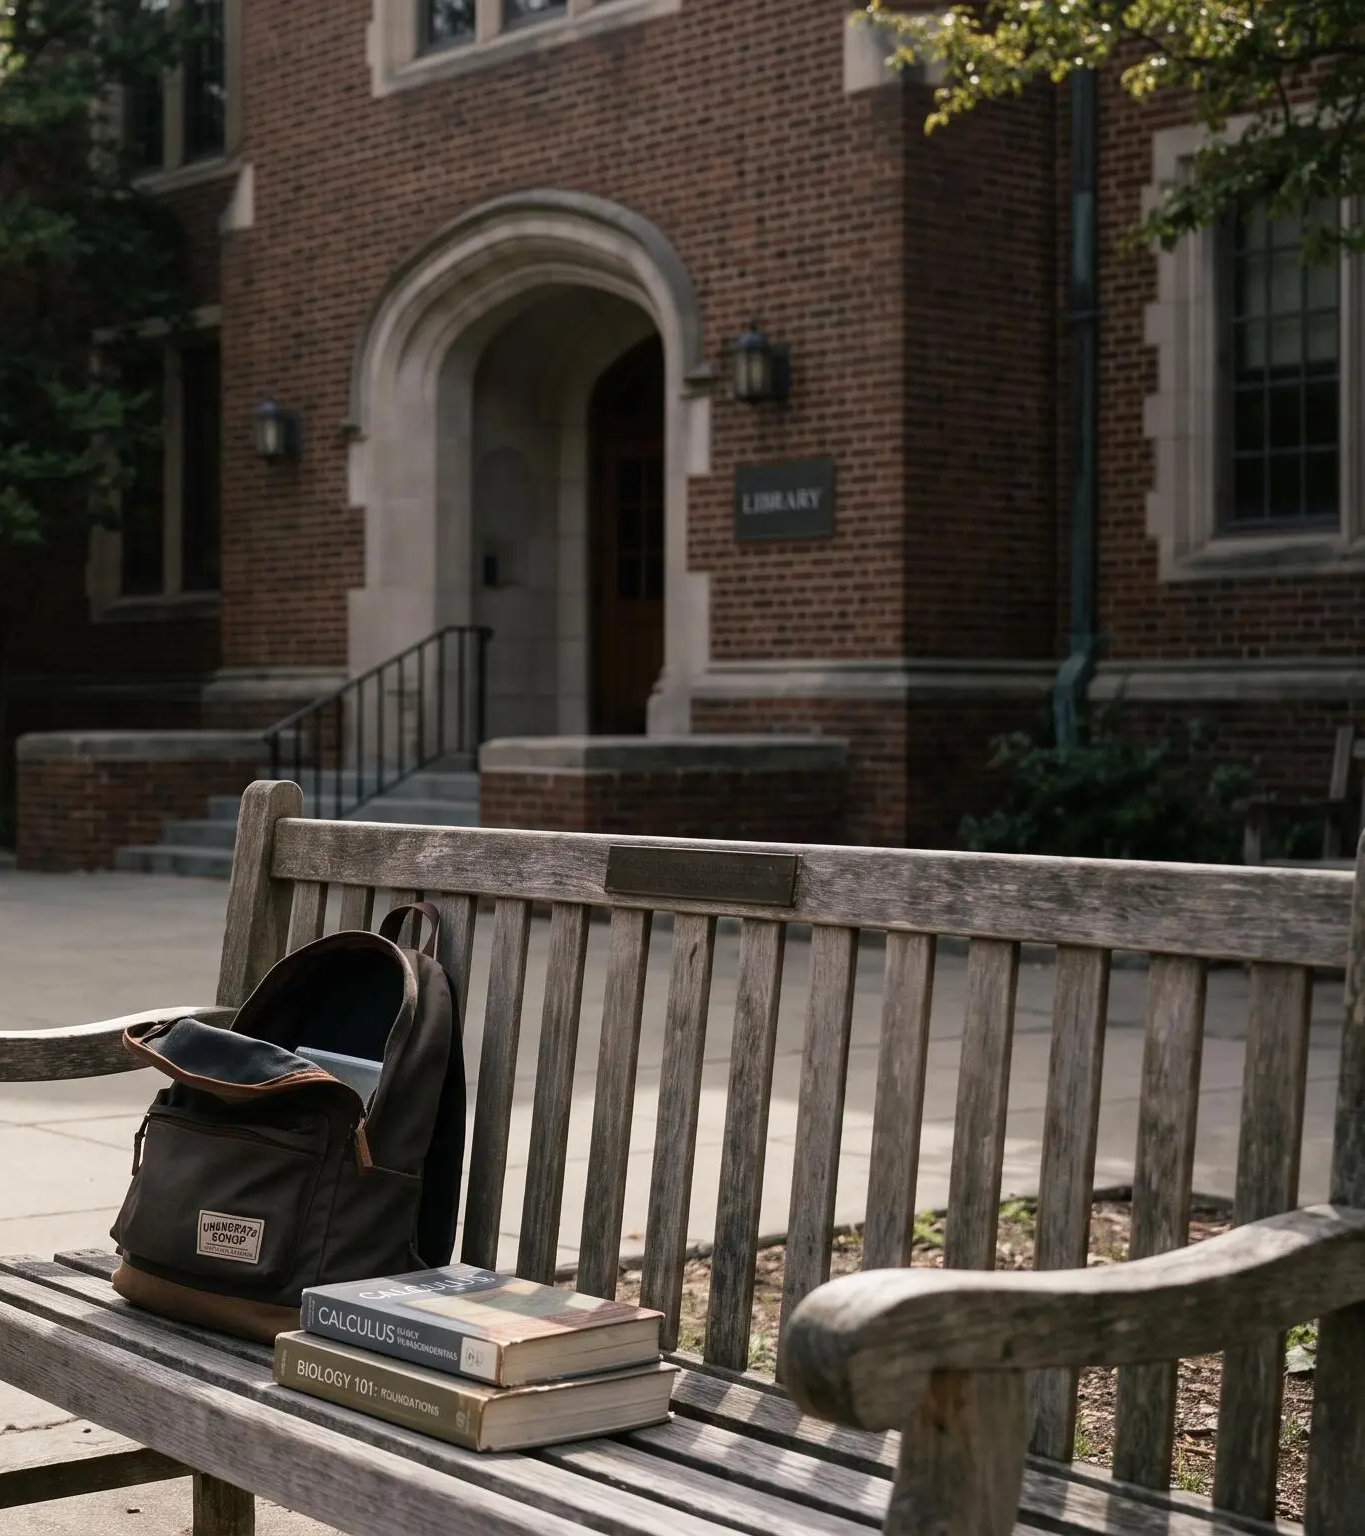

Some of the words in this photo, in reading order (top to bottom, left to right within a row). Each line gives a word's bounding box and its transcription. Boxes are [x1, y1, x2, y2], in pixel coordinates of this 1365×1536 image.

[742, 486, 823, 515] LIBRARY
[318, 1306, 395, 1344] CALCULUS
[297, 1359, 351, 1389] BIOLOGY
[354, 1377, 378, 1397] 101:
